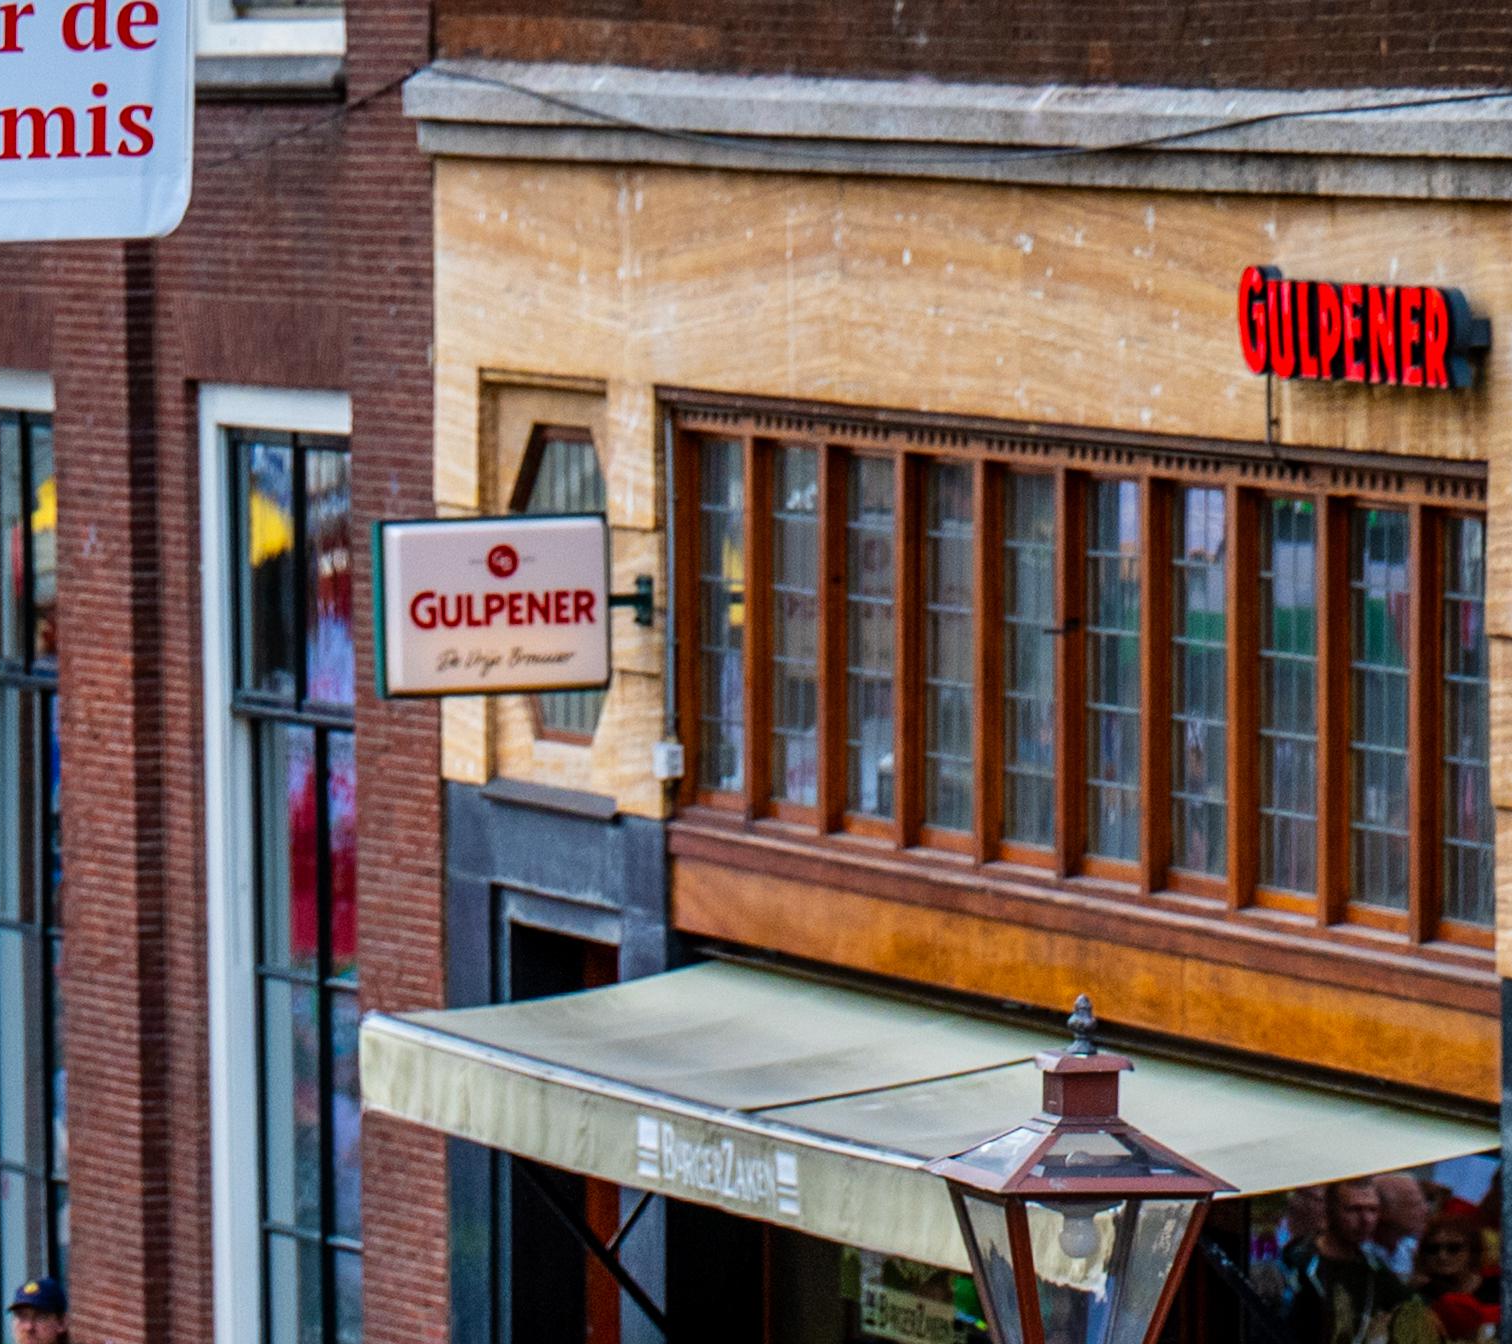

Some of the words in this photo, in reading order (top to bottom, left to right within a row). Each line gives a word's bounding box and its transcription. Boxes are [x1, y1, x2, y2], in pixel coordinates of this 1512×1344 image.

[62, 0, 159, 53] de
[1238, 265, 1449, 389] GULPENER
[410, 590, 595, 629] GULPENER
